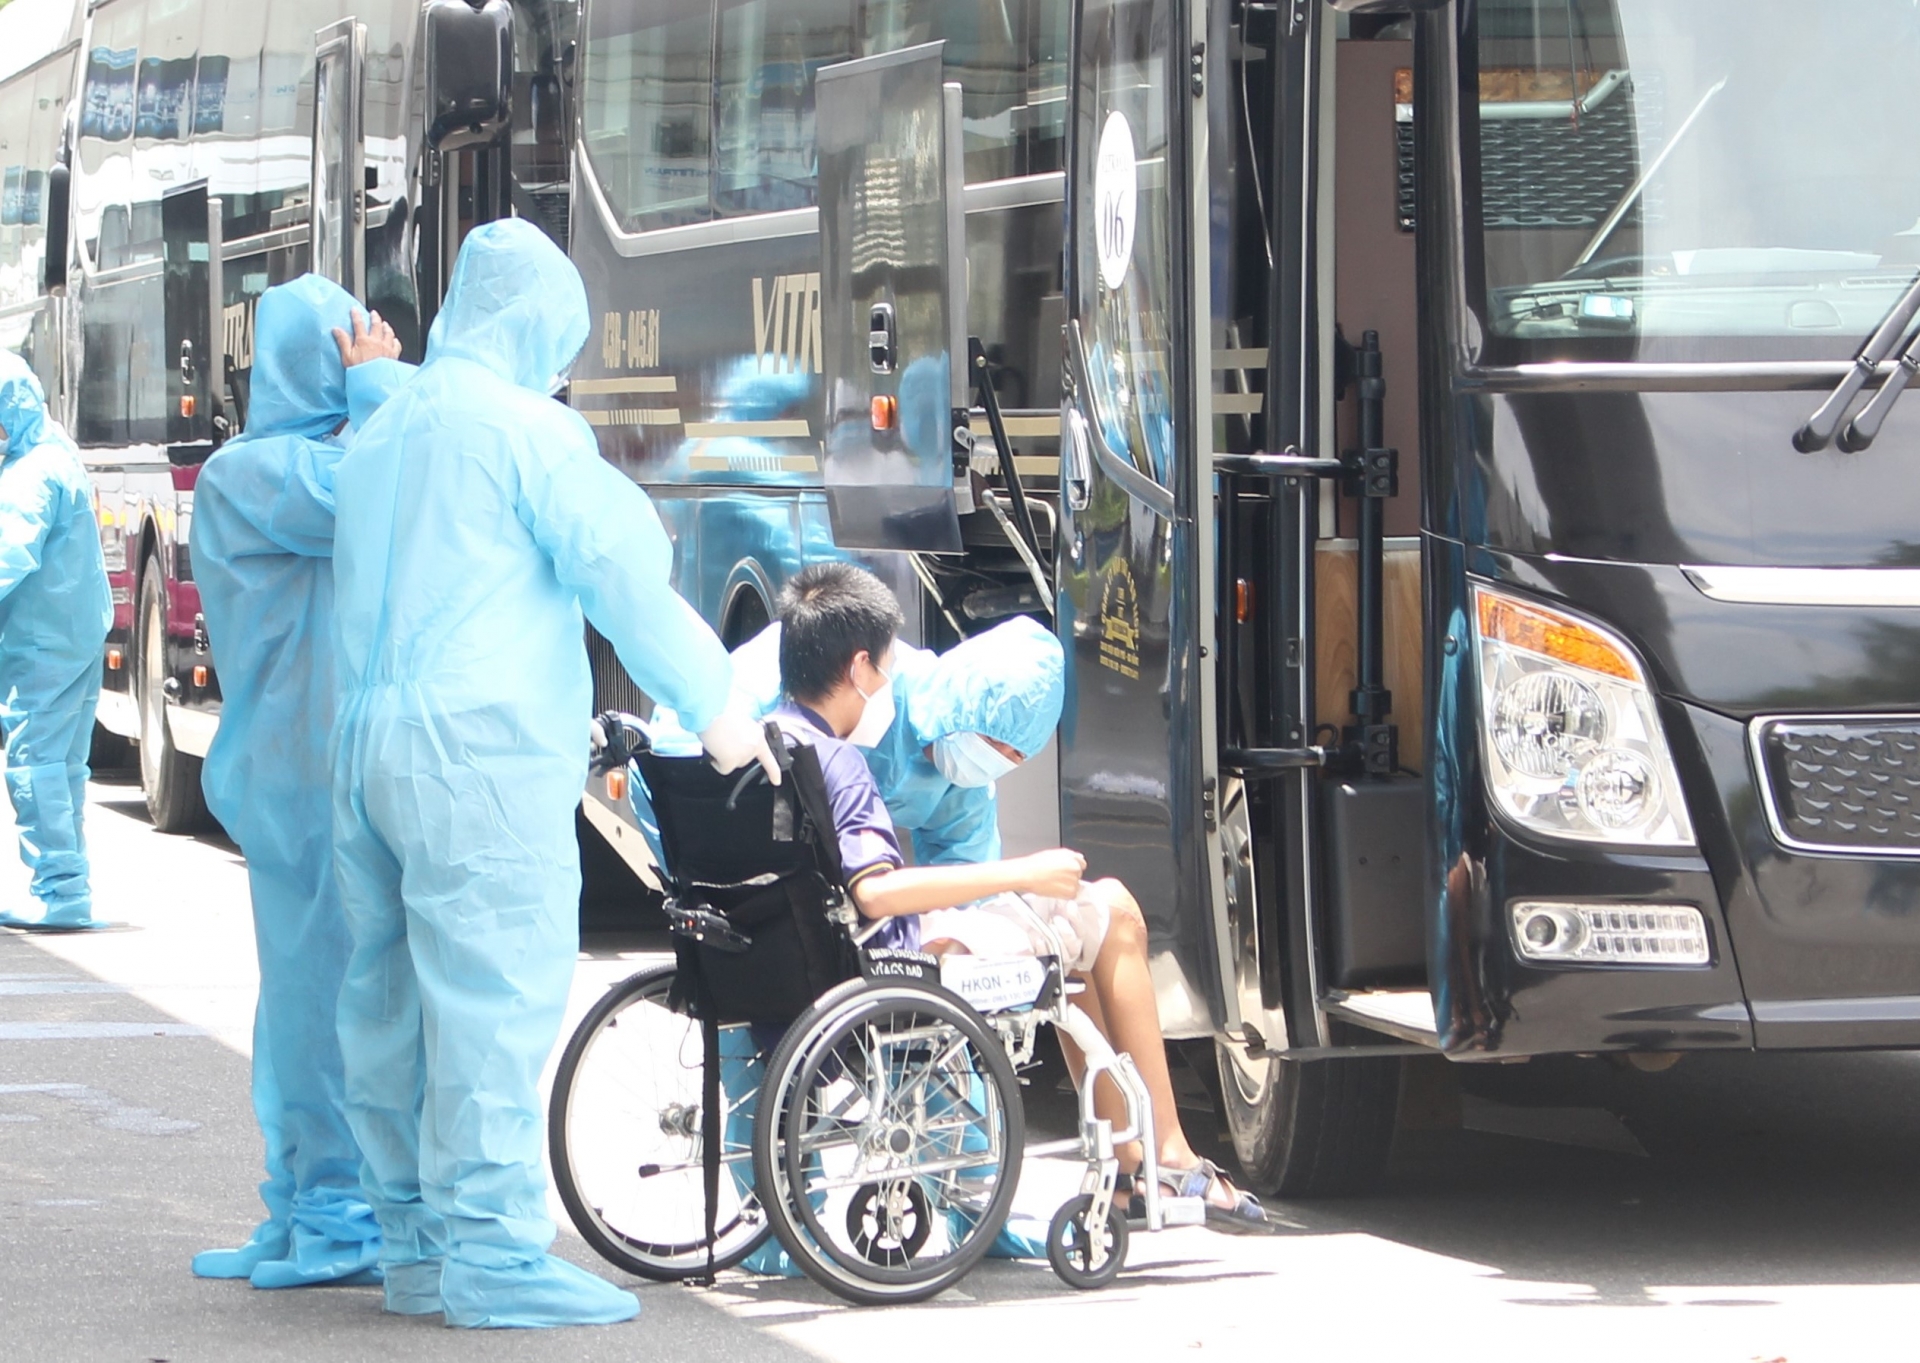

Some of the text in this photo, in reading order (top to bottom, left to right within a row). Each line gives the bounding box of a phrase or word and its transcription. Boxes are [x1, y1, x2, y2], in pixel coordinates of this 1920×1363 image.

[1104, 190, 1125, 259] 06
[752, 272, 823, 374] VITR
[961, 974, 1002, 993] HKQN
[1015, 970, 1032, 985] 16
